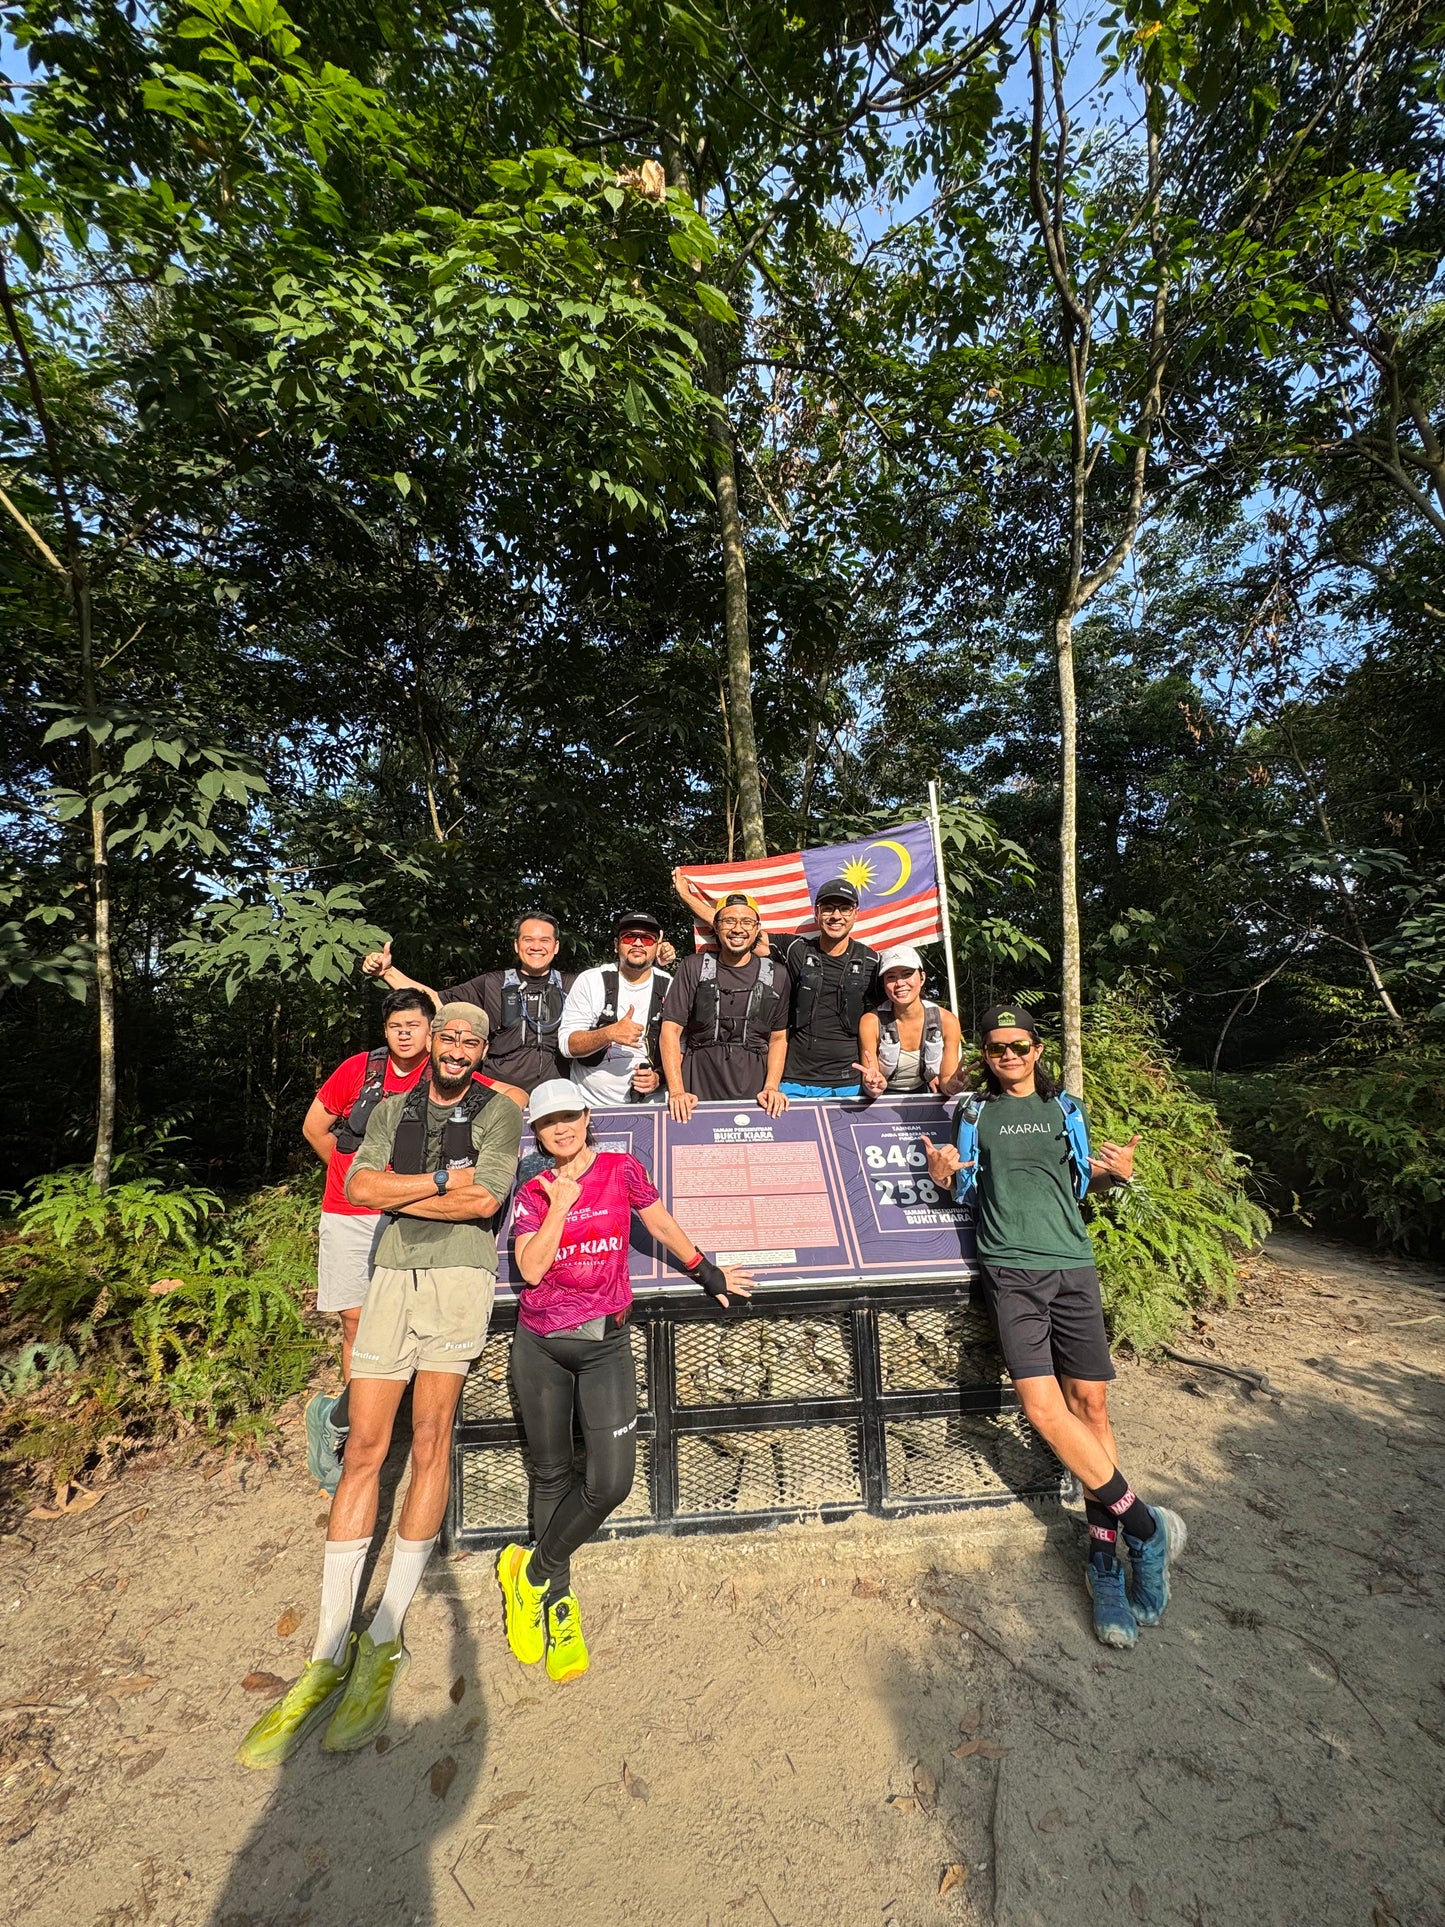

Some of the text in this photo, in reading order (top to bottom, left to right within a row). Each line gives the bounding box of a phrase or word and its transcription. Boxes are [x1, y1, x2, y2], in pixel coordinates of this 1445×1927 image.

[713, 1131, 774, 1140] BUKIT KIARA
[999, 1123, 1050, 1136] AKARALI
[864, 1145, 927, 1169] 846
[875, 1179, 940, 1206] 258
[565, 1209, 609, 1223] TO CLIMB
[567, 1207, 591, 1217] MADE
[906, 1213, 973, 1225] BUKIT KIARA
[580, 1235, 623, 1254] KIAR
